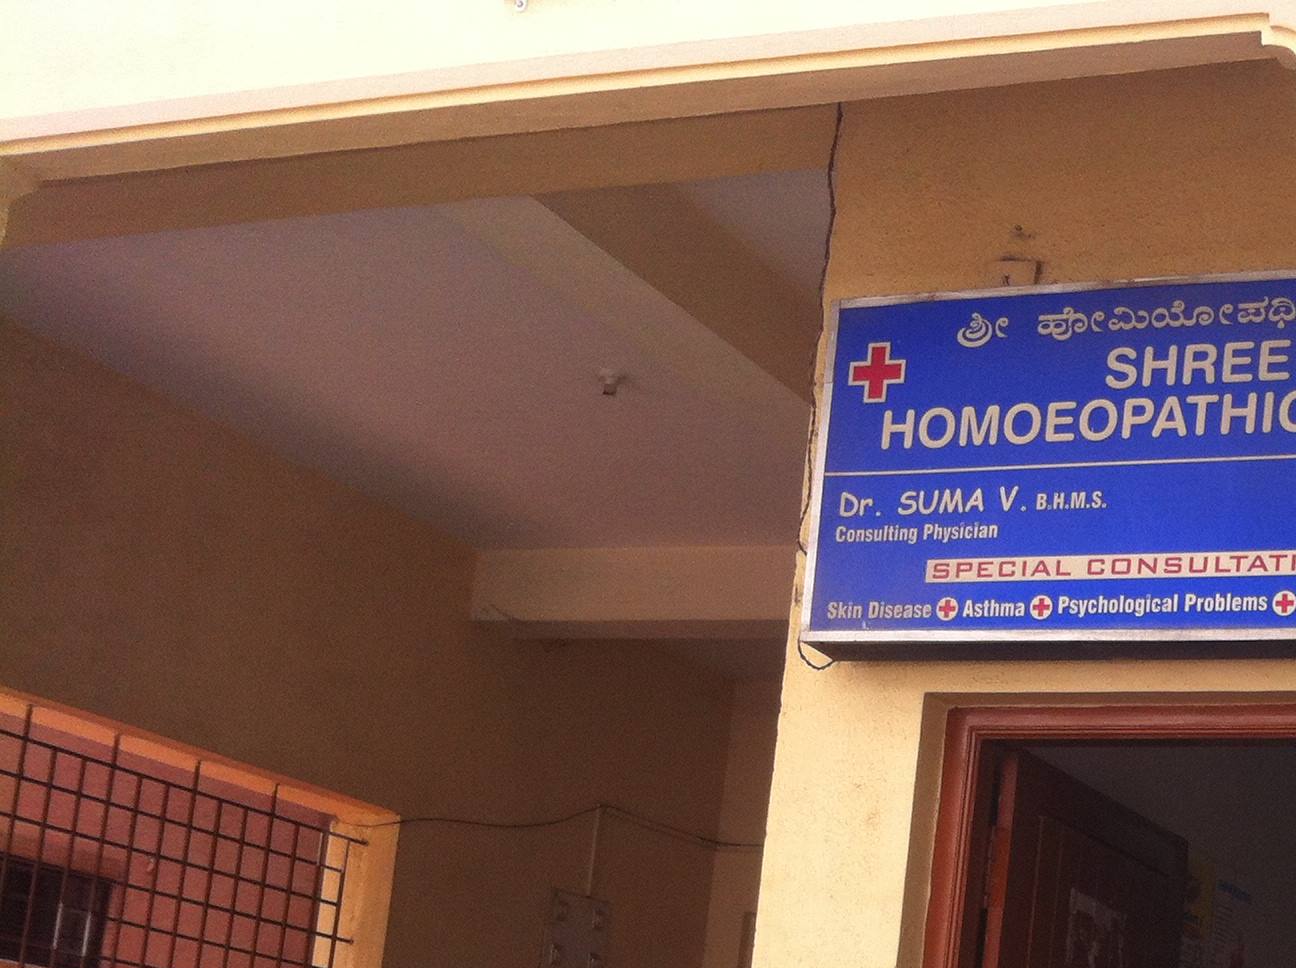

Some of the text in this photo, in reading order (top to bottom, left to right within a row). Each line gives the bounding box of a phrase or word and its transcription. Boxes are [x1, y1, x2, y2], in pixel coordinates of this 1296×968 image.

[956, 310, 1010, 348] ಶ್ರೀ
[1104, 337, 1293, 390] SHREE
[838, 491, 881, 517] Dr.
[897, 487, 985, 515] SUMA
[1035, 492, 1107, 512] B.H.M.S.
[835, 522, 998, 545] Consulting Physician
[931, 558, 1071, 580] SPECIAL
[827, 599, 932, 620] Skin Disease
[962, 596, 1025, 617] Asthma
[1057, 592, 1269, 618] Psychological Problems
